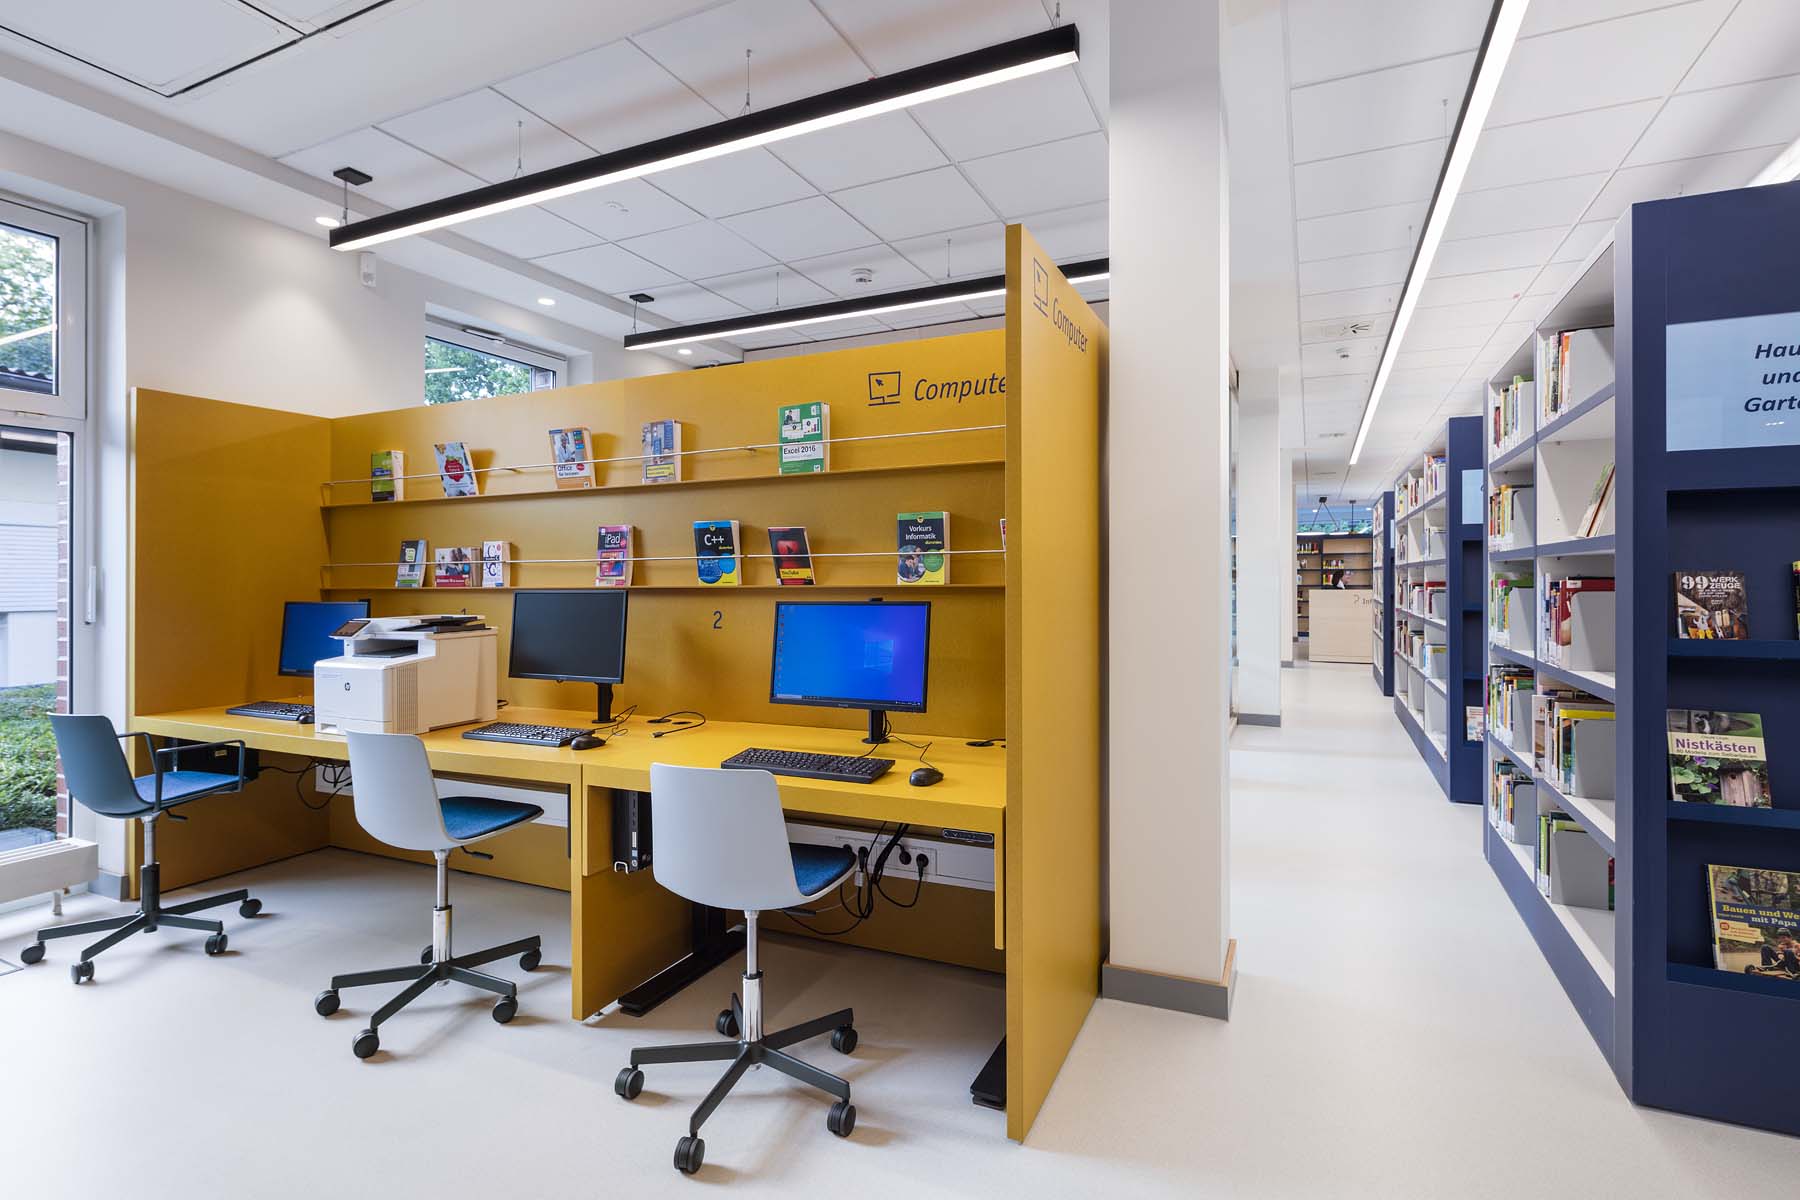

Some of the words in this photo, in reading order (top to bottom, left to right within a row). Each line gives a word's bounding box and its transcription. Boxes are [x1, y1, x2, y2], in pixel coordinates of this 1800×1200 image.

[1052, 298, 1088, 353] Computer
[914, 372, 1006, 403] Compute
[784, 447, 800, 455] Excel
[801, 445, 816, 453] 2016
[605, 533, 620, 544] iPad
[704, 534, 725, 546] C++
[1682, 575, 1709, 590] 99
[713, 610, 723, 629] 2
[1675, 739, 1756, 754] Nistkästen
[1722, 904, 1756, 914] Bauen
[1751, 916, 1769, 924] mit
[1771, 918, 1797, 927] Papa
